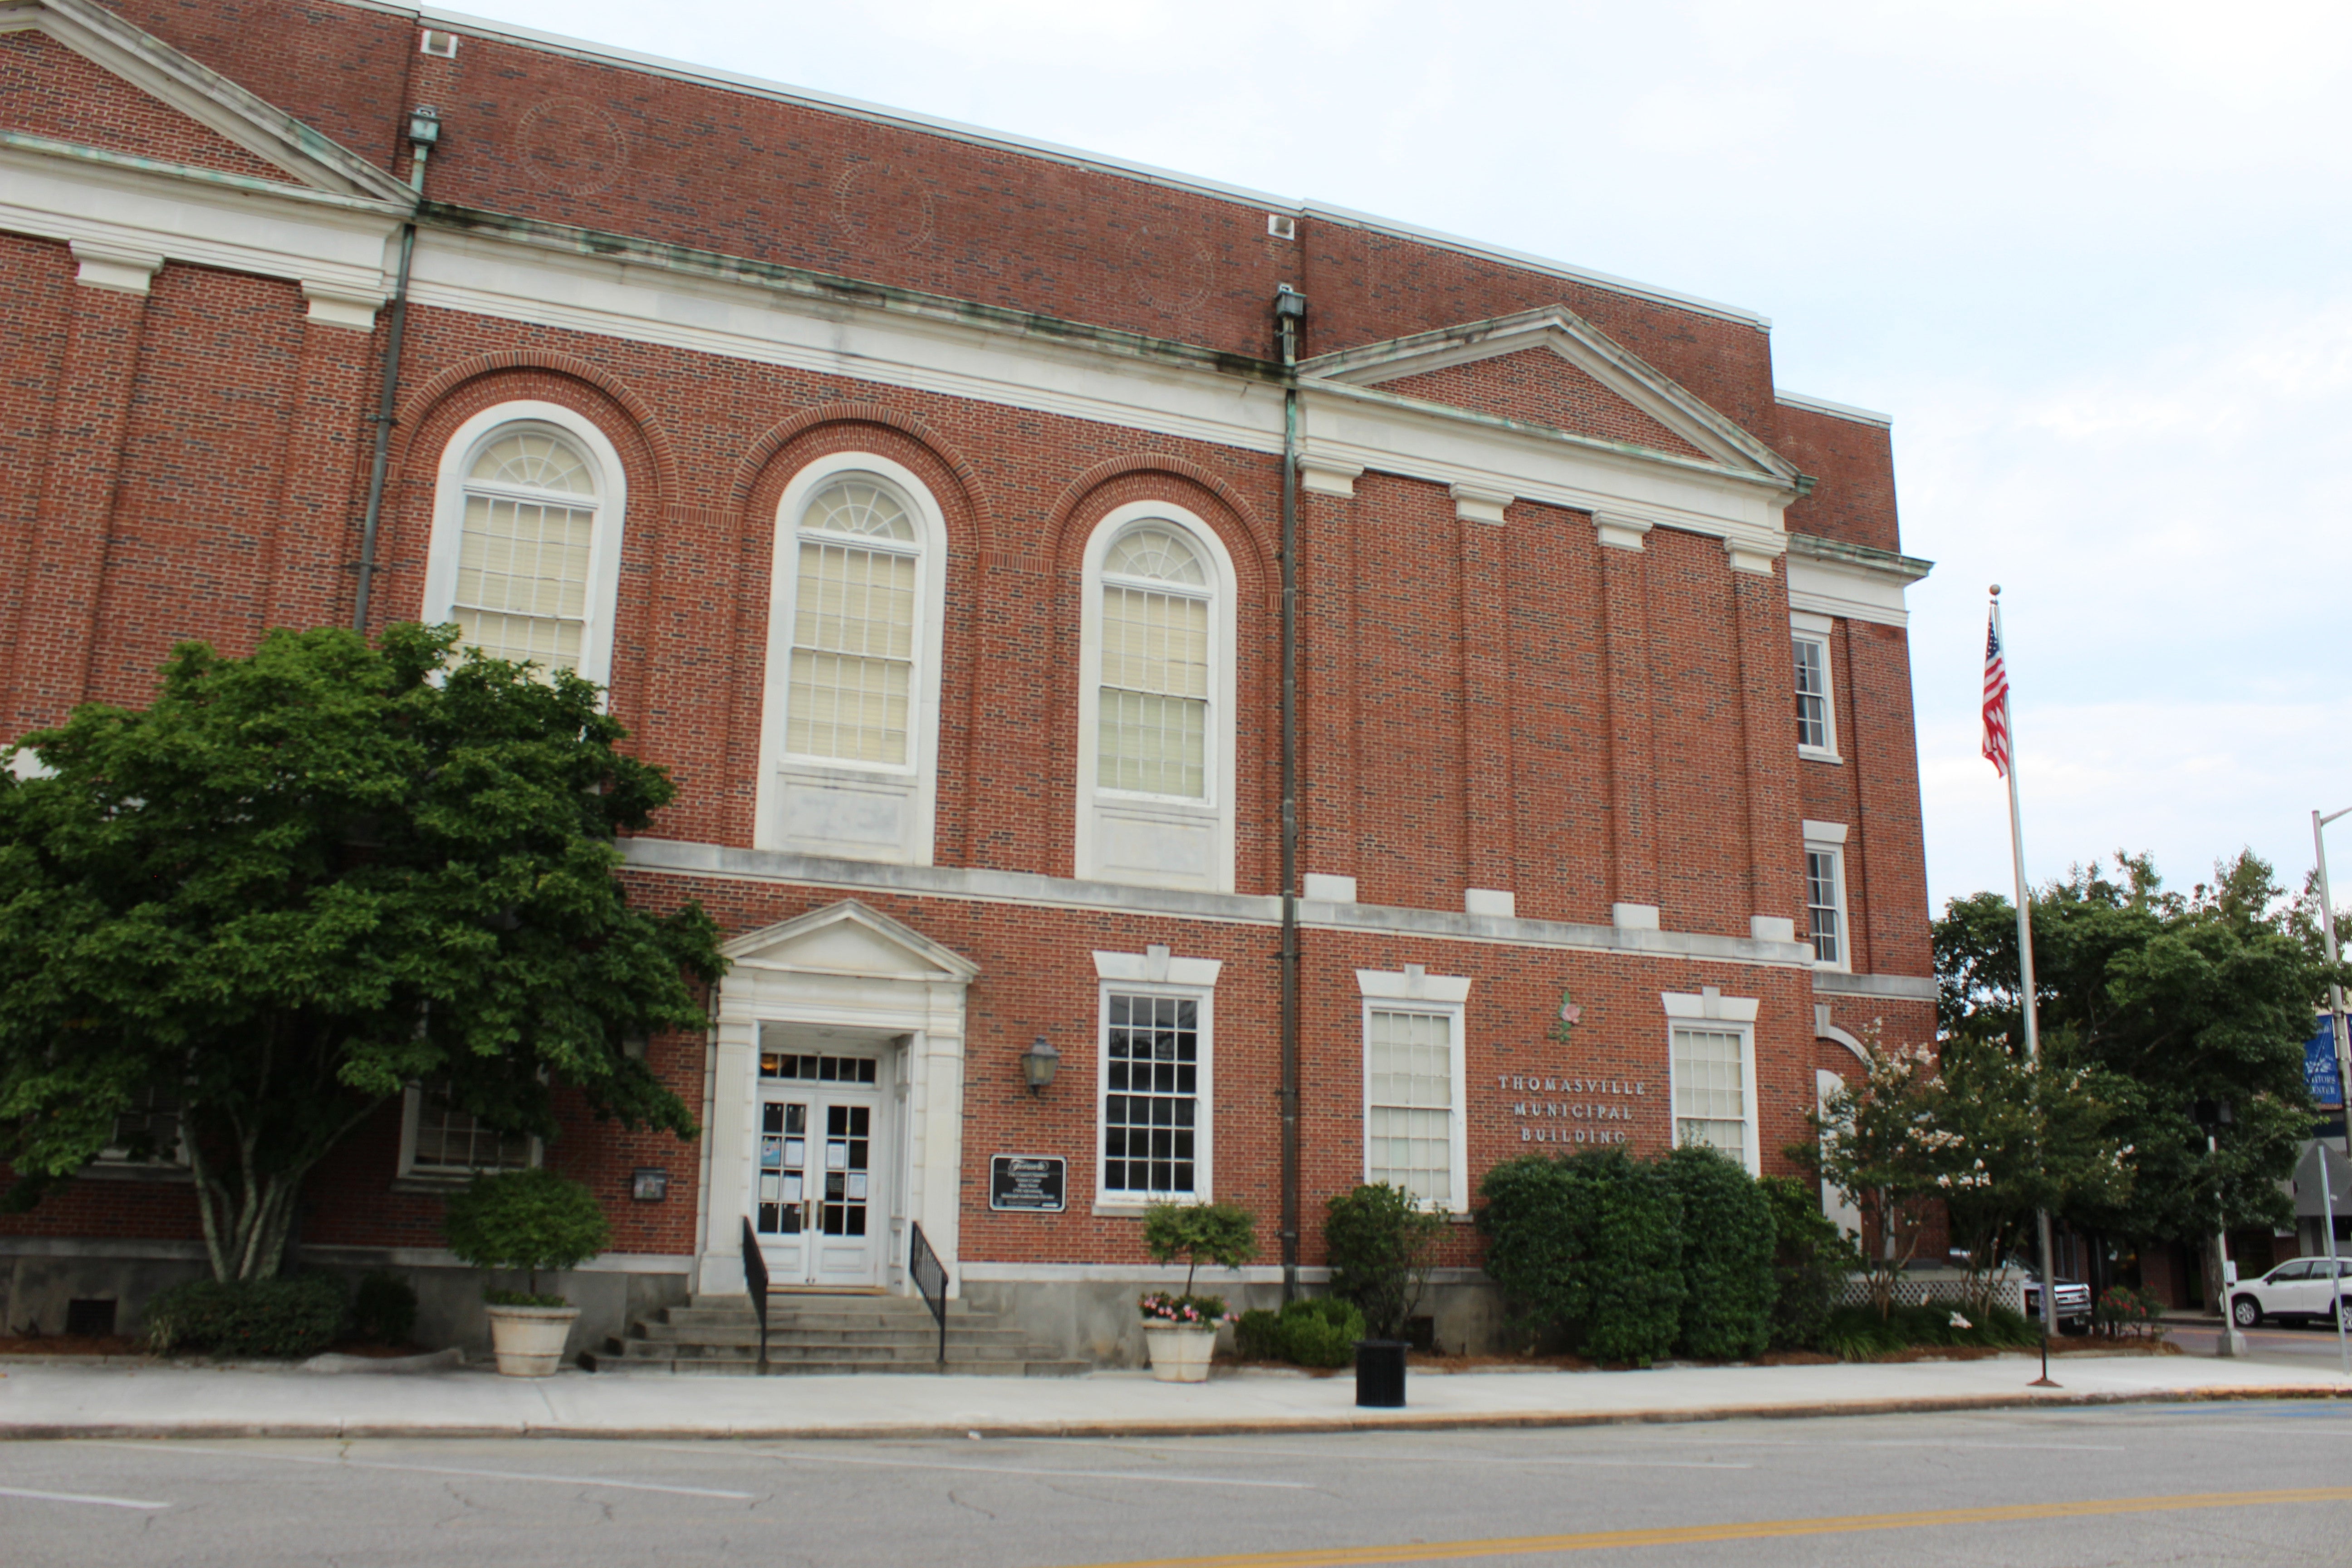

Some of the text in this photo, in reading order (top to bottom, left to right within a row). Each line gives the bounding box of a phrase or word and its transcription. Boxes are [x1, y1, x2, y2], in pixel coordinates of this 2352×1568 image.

[1498, 1075, 1645, 1095] THOMASVILLE
[2306, 1075, 2335, 1084] SITORS
[1514, 1102, 1632, 1120] MUNICIPAL
[1521, 1128, 1626, 1144] BUILDING
